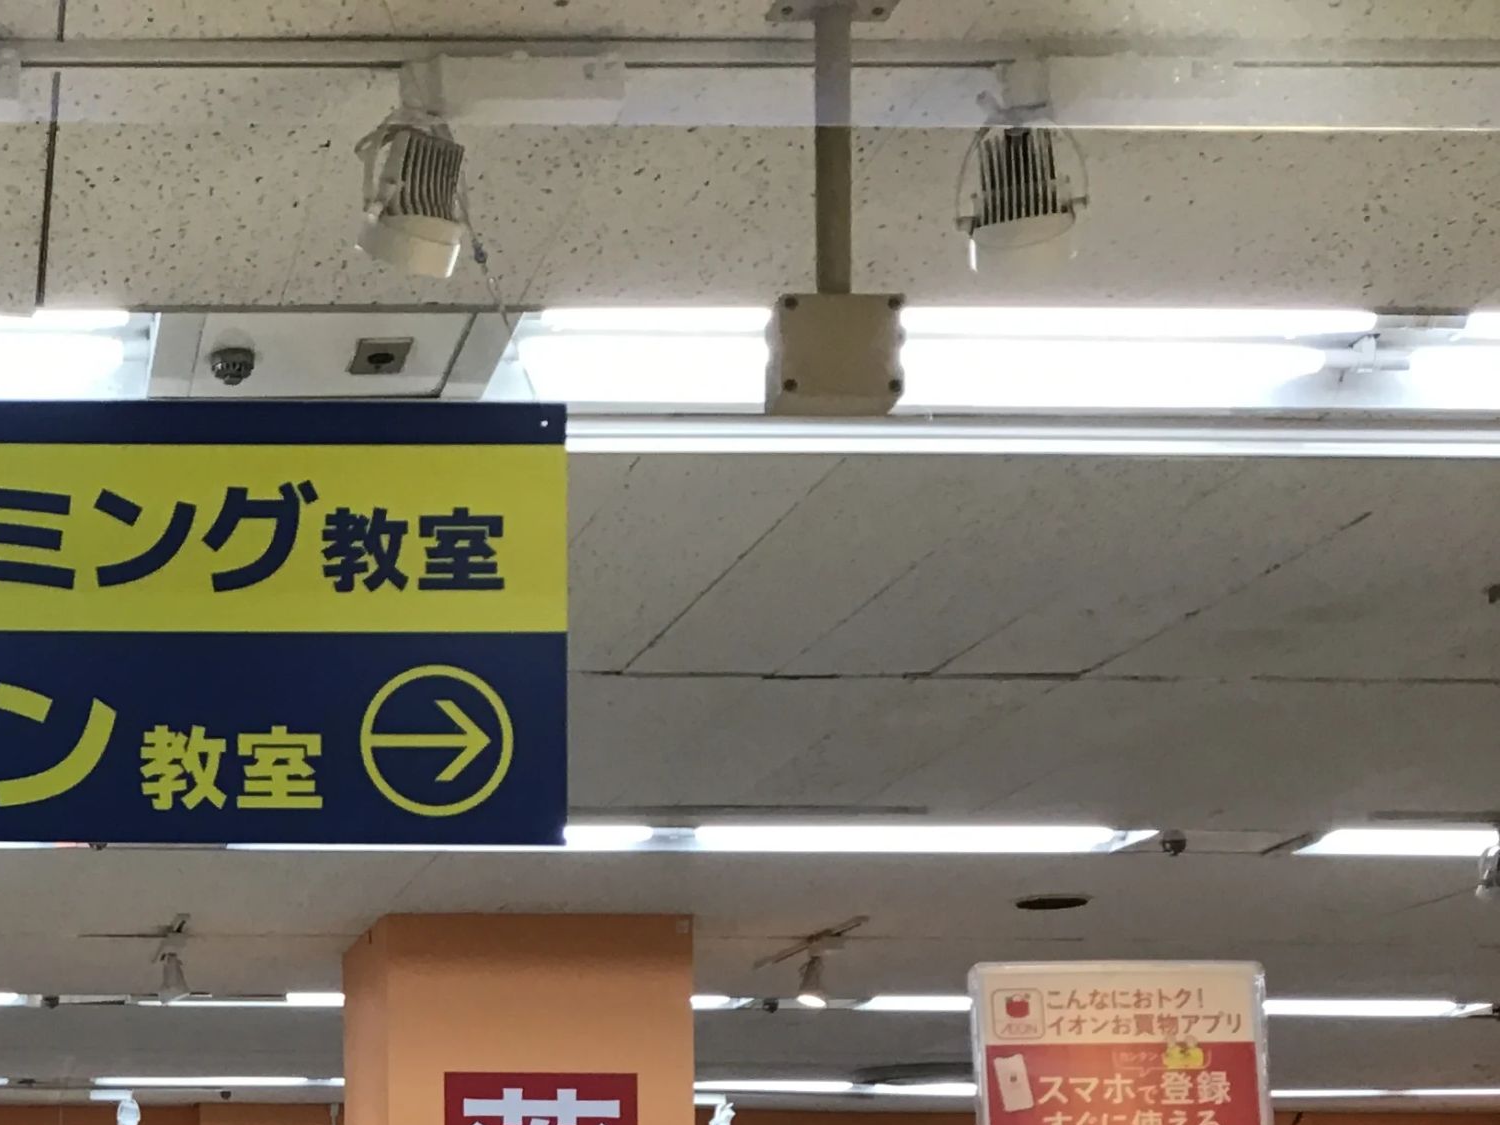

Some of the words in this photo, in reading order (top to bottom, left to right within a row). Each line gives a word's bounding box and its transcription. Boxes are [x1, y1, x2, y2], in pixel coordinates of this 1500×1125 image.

[1047, 1013, 1243, 1035] イオンお買物アプリ
[1038, 1071, 1231, 1105] スマホで登録
